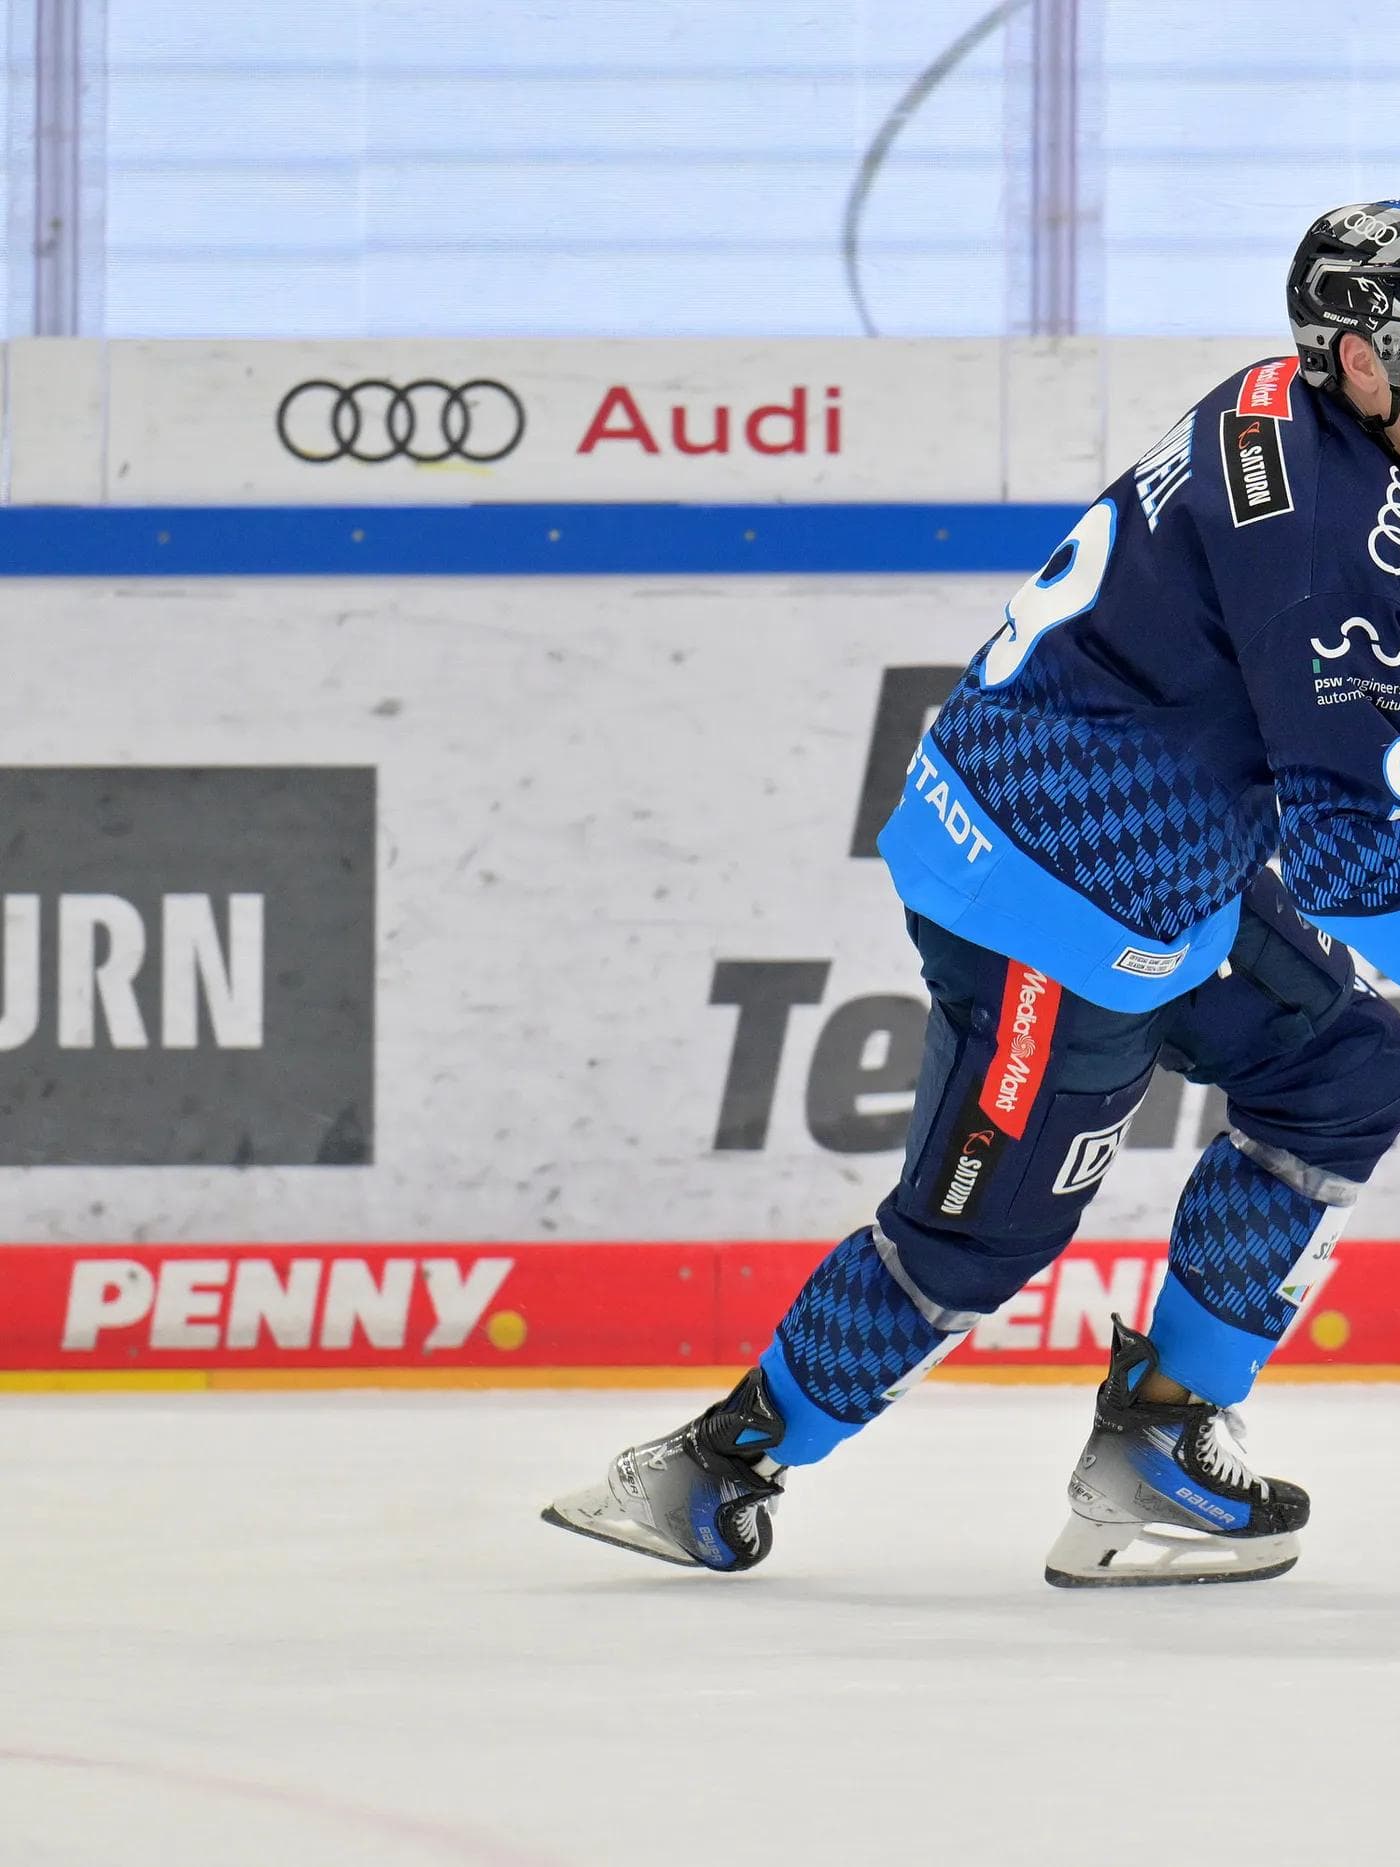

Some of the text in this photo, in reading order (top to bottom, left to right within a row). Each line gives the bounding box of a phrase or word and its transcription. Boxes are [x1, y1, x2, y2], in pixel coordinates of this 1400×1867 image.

[575, 385, 841, 456] Audi
[1239, 445, 1272, 507] SATURN
[1314, 676, 1343, 693] psw
[940, 1156, 983, 1216] SATURN
